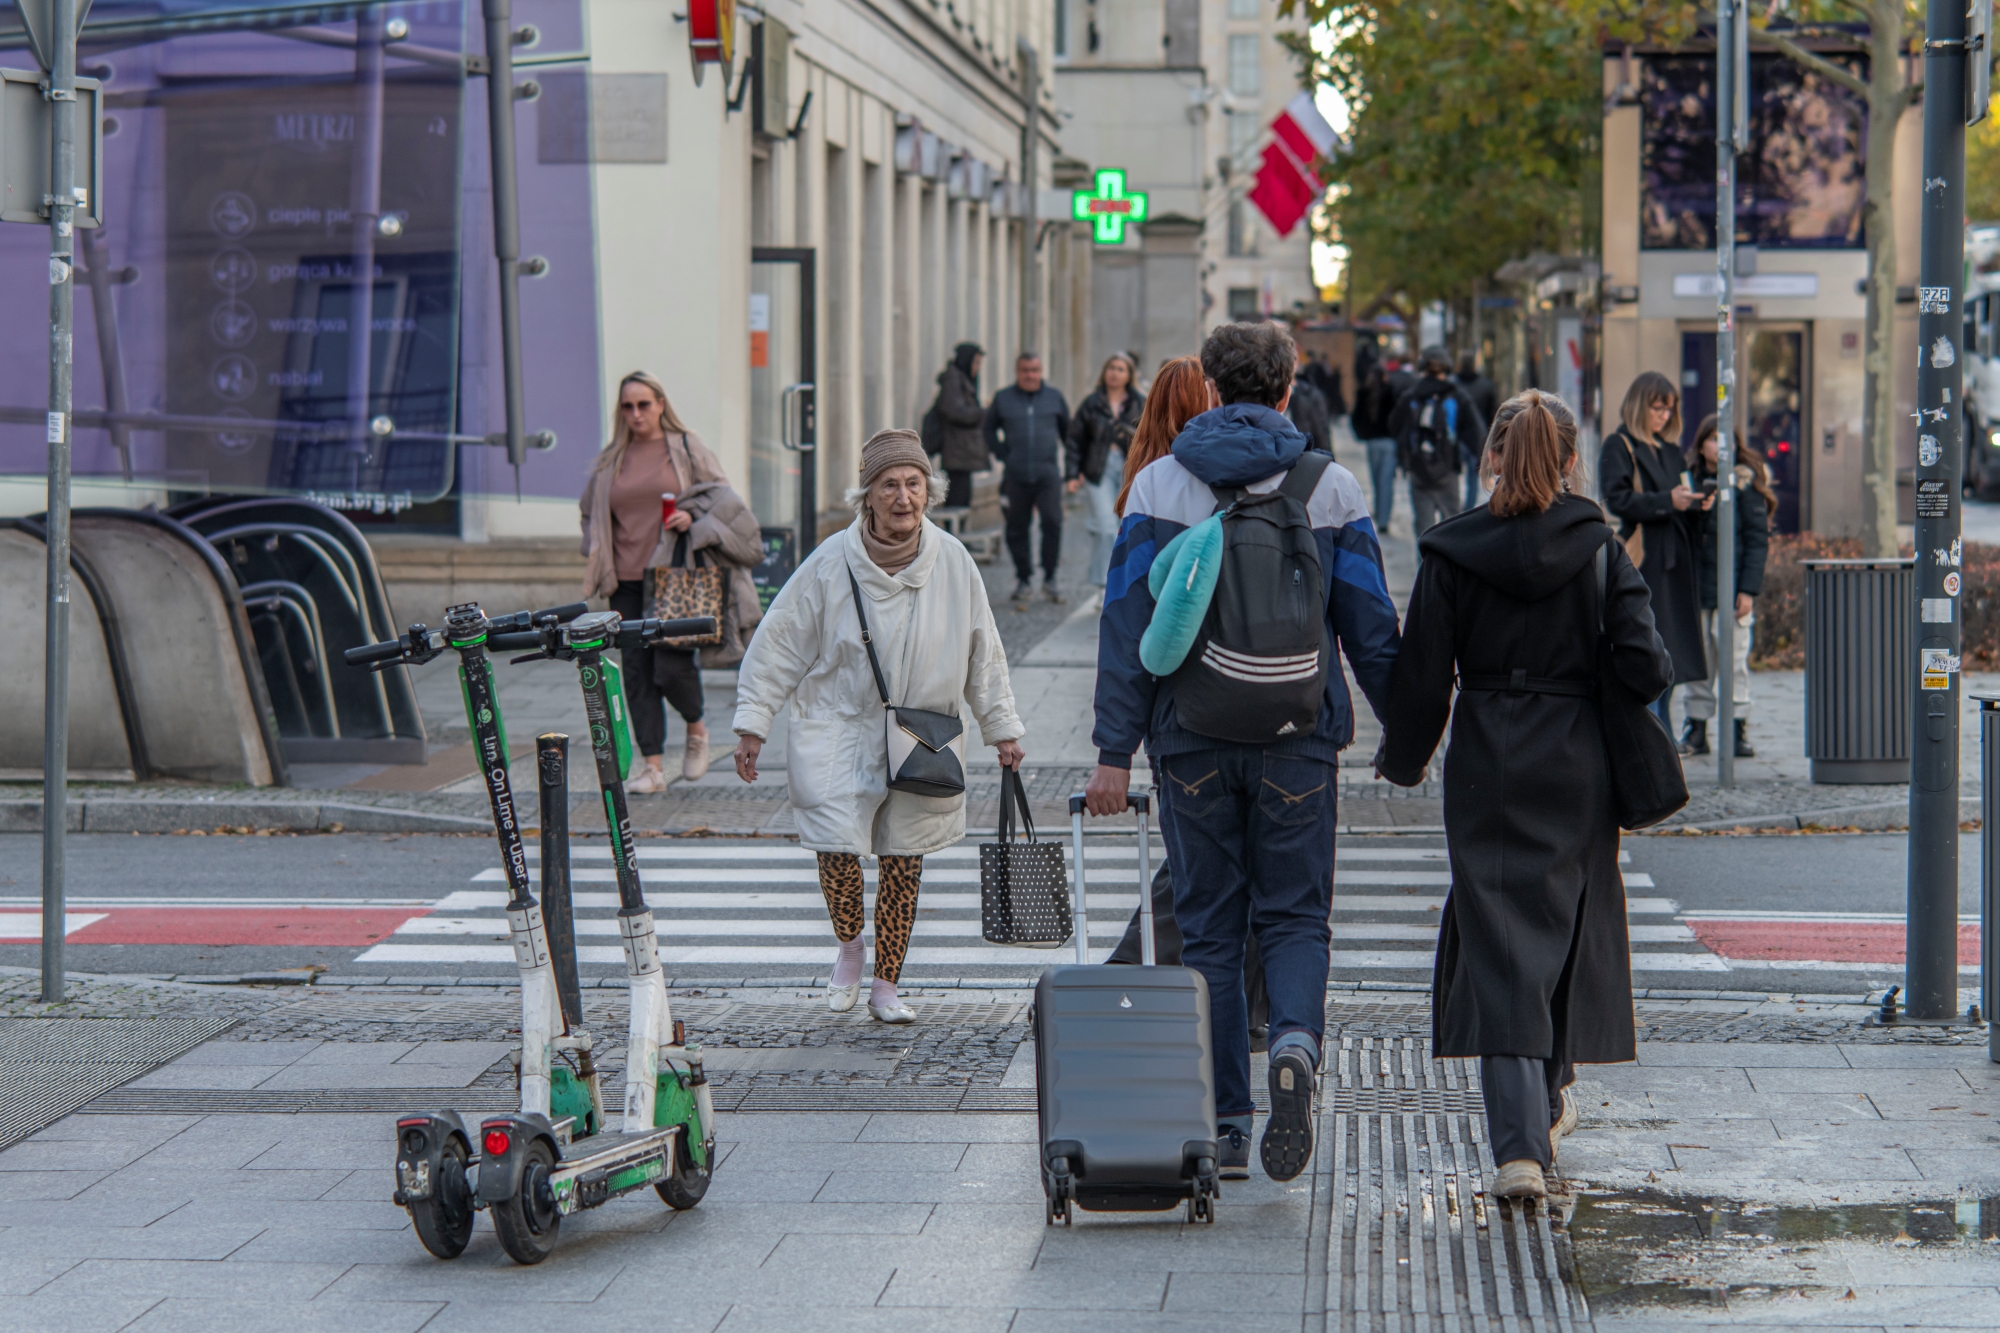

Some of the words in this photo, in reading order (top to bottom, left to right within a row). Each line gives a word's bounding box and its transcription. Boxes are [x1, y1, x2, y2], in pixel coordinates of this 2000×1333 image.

[492, 768, 505, 791] On
[496, 792, 515, 830] Lime
[509, 833, 519, 841] +
[620, 817, 638, 871] Lime
[509, 843, 528, 880] Uber
